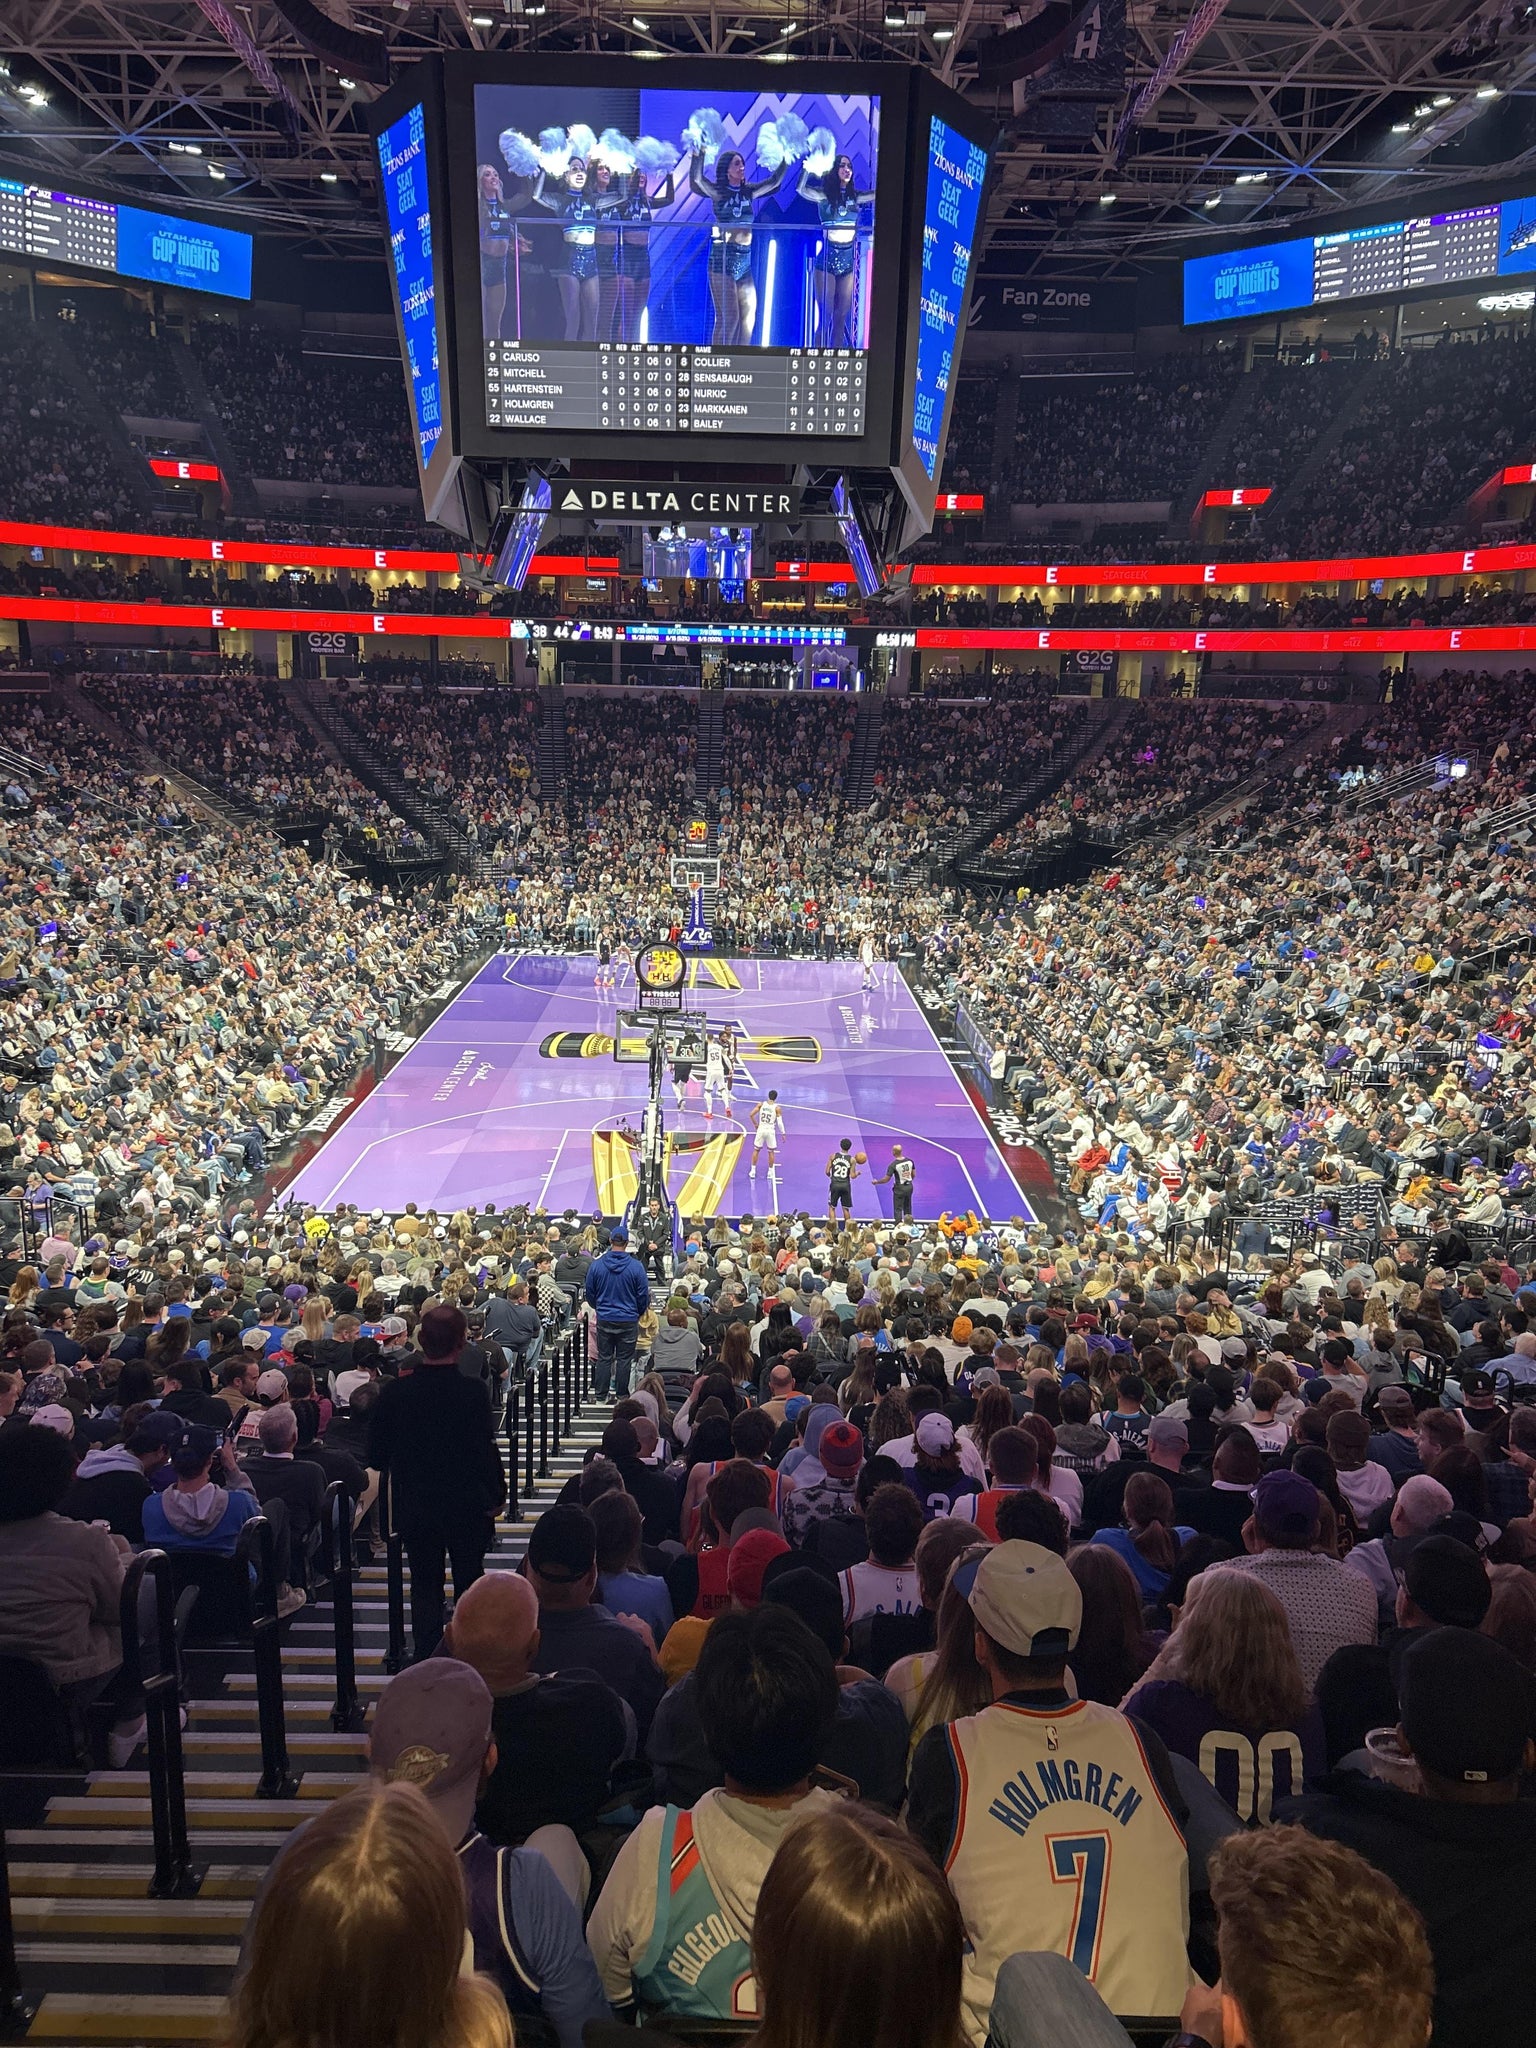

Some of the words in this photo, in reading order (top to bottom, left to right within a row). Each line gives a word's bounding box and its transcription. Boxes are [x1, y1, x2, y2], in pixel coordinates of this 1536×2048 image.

[387, 154, 403, 175] ZIONS
[403, 140, 421, 163] BANK
[934, 152, 955, 177] ZIONS
[956, 167, 974, 190] BANK
[397, 166, 413, 194] SEAT
[399, 186, 417, 214] GEEK
[941, 179, 961, 207] SEAT
[938, 200, 959, 229] GEEK
[1416, 218, 1431, 228] JAZZ
[159, 230, 187, 241] UTAH
[188, 237, 213, 248] JAZZ
[153, 236, 176, 263] CUP
[178, 241, 219, 272] NIGHTS
[1221, 265, 1247, 275] UTAH
[1249, 261, 1273, 270] JAZZ
[1215, 274, 1237, 300] CUP
[1239, 267, 1279, 296] NIGHTS
[1002, 288, 1038, 304] Fan
[1042, 289, 1090, 306] Zone
[937, 307, 955, 326] BANK
[489, 352, 496, 361] 9
[503, 353, 540, 362] CARUSO
[602, 356, 608, 364] 2
[618, 357, 625, 365] 0
[634, 357, 639, 365] 2
[665, 357, 671, 366] 0
[694, 358, 730, 367] COLLIER
[809, 361, 815, 369] 0
[825, 362, 831, 370] 2
[838, 362, 848, 370] 07
[856, 362, 862, 370] 0
[488, 368, 499, 376] 25
[503, 369, 546, 378] MITCHELL
[619, 372, 624, 380] 3
[634, 372, 640, 380] 0
[648, 373, 658, 381] 07
[665, 373, 671, 381] 0
[678, 373, 689, 381] 28
[694, 373, 752, 383] SENSABAUGH
[792, 376, 798, 384] 0
[809, 377, 815, 385] 0
[824, 377, 830, 385] 0
[837, 378, 848, 386] 02
[855, 378, 861, 386] 0
[421, 382, 435, 404] SEAT
[488, 384, 499, 392] 55
[504, 384, 562, 394] HARTENSTEIN
[602, 387, 608, 395] 4
[619, 387, 625, 395] 0
[634, 388, 639, 396] 2
[665, 388, 671, 397] 0
[678, 388, 689, 397] 30
[694, 389, 727, 397] NURKIC
[792, 392, 797, 400] 2
[808, 392, 814, 400] 2
[825, 393, 829, 401] 1
[855, 393, 859, 401] 1
[492, 399, 497, 407] 7
[505, 400, 553, 409] HOLMGREN
[619, 403, 625, 411] 0
[634, 403, 640, 412] 0
[648, 404, 658, 412] 07
[665, 404, 671, 412] 0
[678, 404, 689, 412] 23
[694, 405, 747, 414] MARKKANEN
[790, 408, 797, 416] 11
[808, 408, 814, 416] 4
[824, 408, 828, 416] 1
[838, 408, 844, 416] 11
[854, 409, 860, 417] 0
[917, 392, 934, 416] SEAT
[423, 406, 439, 423] GEEK
[489, 414, 500, 422] 22
[505, 415, 546, 423] WALLACE
[620, 418, 624, 426] 1
[666, 419, 670, 427] 1
[679, 420, 688, 428] 19
[694, 420, 723, 428] BAILEY
[790, 422, 796, 430] 2
[807, 423, 813, 431] 0
[823, 423, 828, 431] 1
[854, 424, 858, 432] 1
[914, 416, 933, 435] GEEK
[420, 429, 434, 444] ZIONS
[178, 462, 190, 478] E
[591, 491, 680, 511] DELTA
[691, 493, 790, 513] CENTER
[946, 494, 957, 509] E
[1232, 490, 1242, 504] E
[212, 542, 224, 559] E
[374, 552, 386, 568] E
[1463, 552, 1475, 571] E
[1047, 568, 1058, 583] E
[1204, 566, 1216, 582] E
[212, 609, 224, 626] E
[373, 615, 384, 632] E
[308, 632, 346, 647] G2G
[532, 625, 547, 638] 38
[554, 626, 569, 638] 44
[1451, 631, 1462, 648] E
[1039, 633, 1050, 648] E
[1195, 634, 1206, 648] E
[1076, 650, 1113, 664] G2G
[689, 829, 704, 839] 24
[710, 1052, 720, 1061] 55
[450, 1056, 476, 1075] DELTA
[431, 1077, 461, 1101] CENTER
[761, 1113, 771, 1123] 25
[834, 1165, 848, 1178] 28
[902, 1164, 909, 1172] 30
[987, 1239, 998, 1248] 23
[1200, 1730, 1302, 1826] 00
[989, 1759, 1143, 1837] HOLMGREN
[1045, 1829, 1112, 1982] 7
